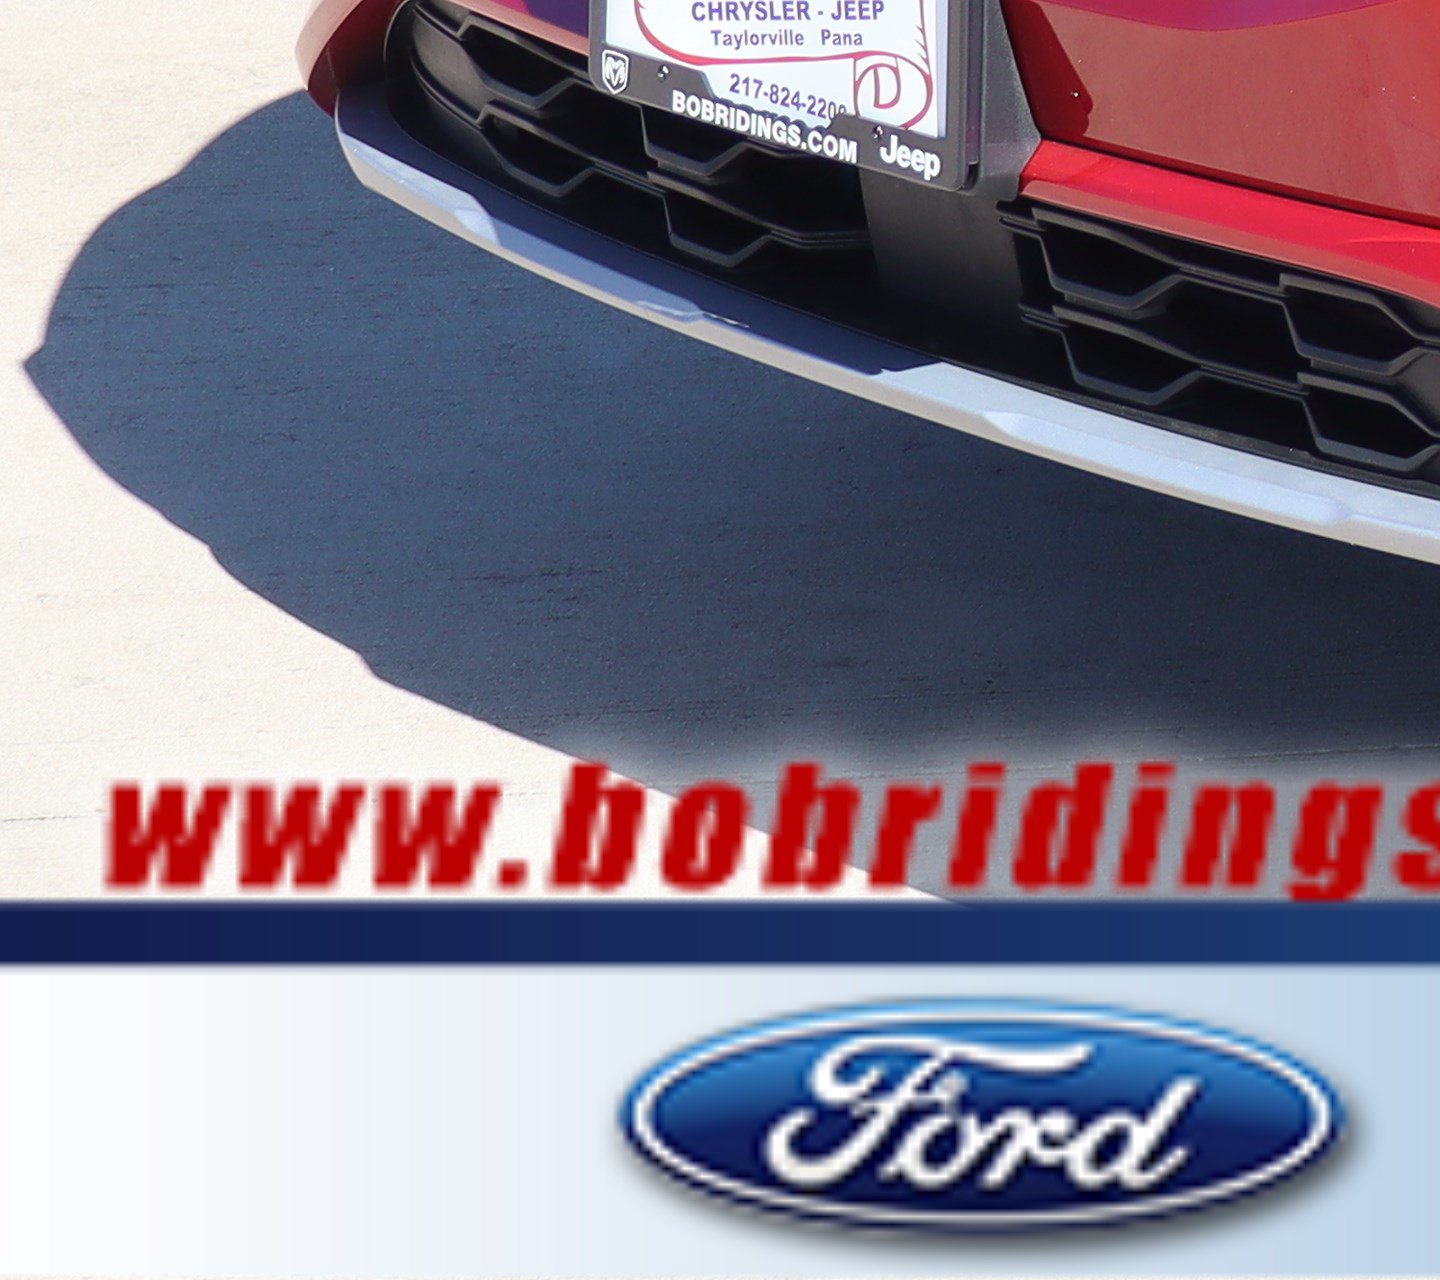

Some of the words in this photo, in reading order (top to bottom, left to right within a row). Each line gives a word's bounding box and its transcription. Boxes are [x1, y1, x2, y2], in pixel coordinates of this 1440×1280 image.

[690, 0, 811, 22] CHRYSLER
[830, 0, 885, 21] JEEP
[710, 28, 804, 51] Taylorville
[820, 28, 864, 47] Pana
[671, 88, 858, 164] BOBRIDINGS.COM
[879, 134, 942, 181] Jeep
